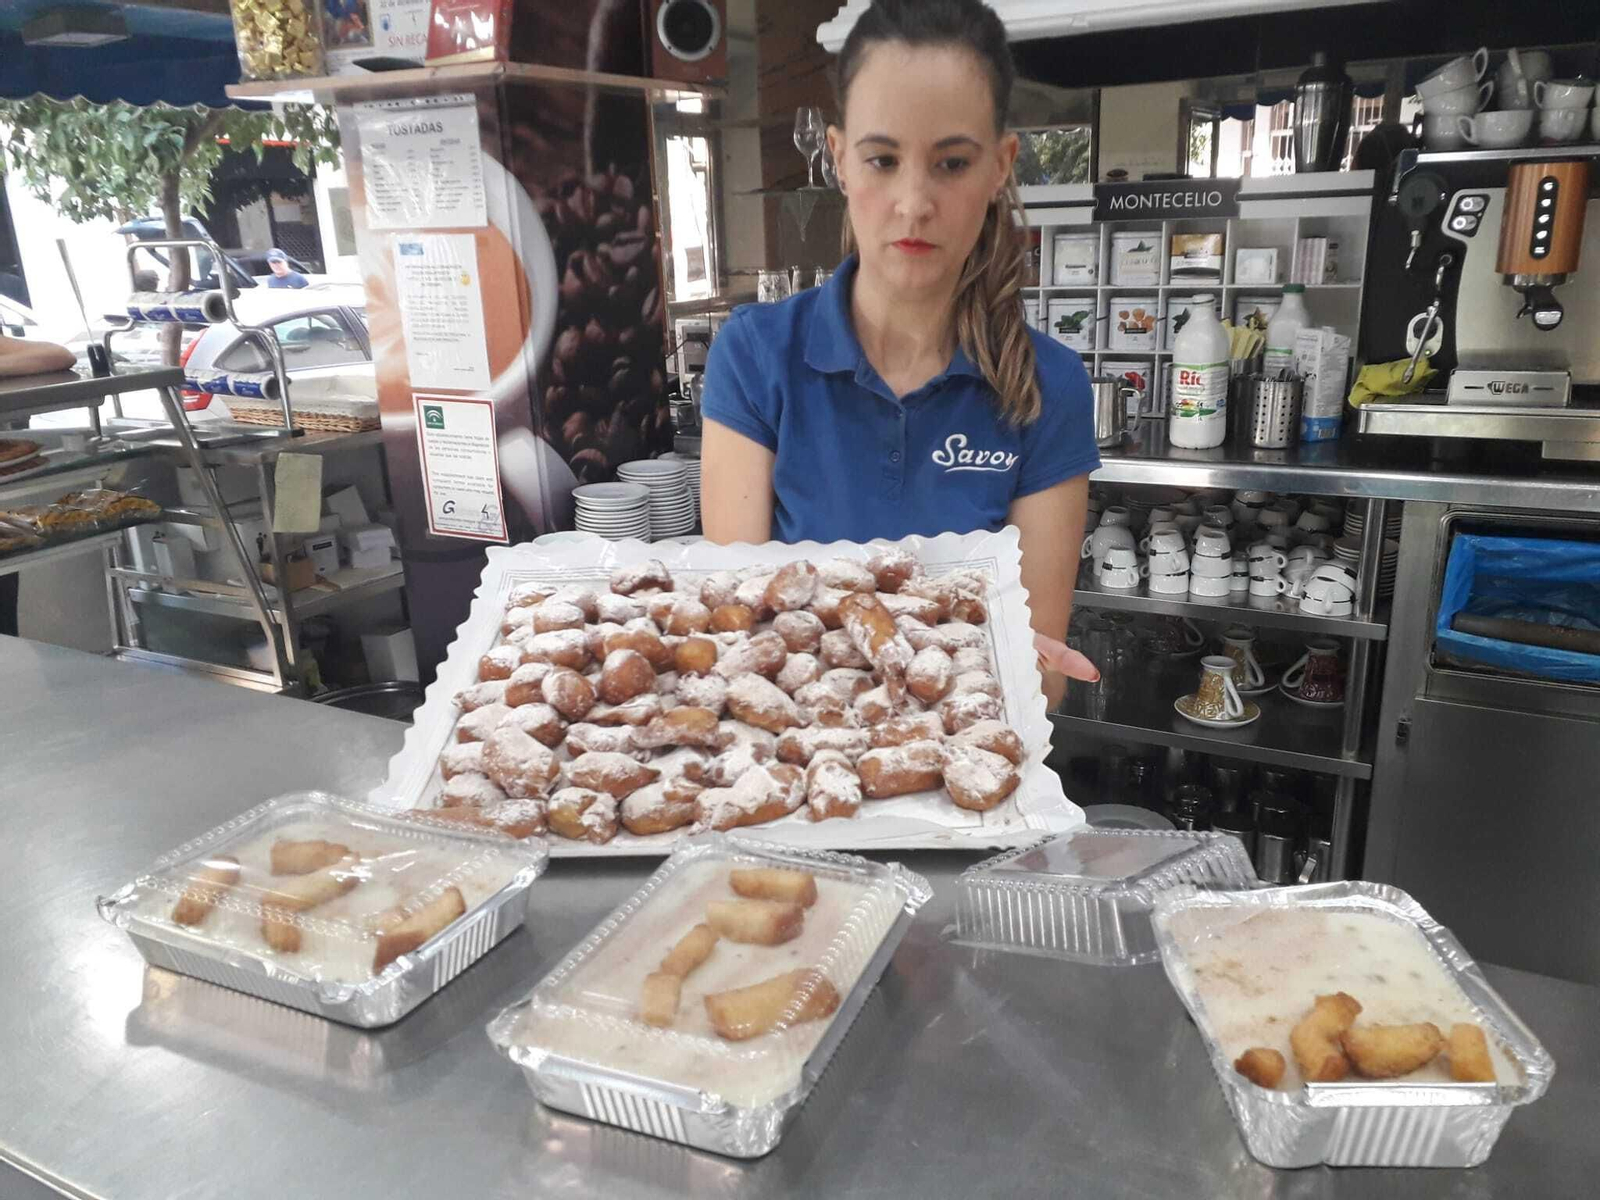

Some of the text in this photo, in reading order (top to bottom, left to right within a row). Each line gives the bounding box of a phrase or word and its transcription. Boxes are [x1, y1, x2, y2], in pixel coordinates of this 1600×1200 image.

[387, 121, 444, 136] TOSTADAS
[1110, 191, 1222, 210] MONTECELIO
[1492, 382, 1529, 394] WEGA
[932, 433, 1019, 472] Savoy
